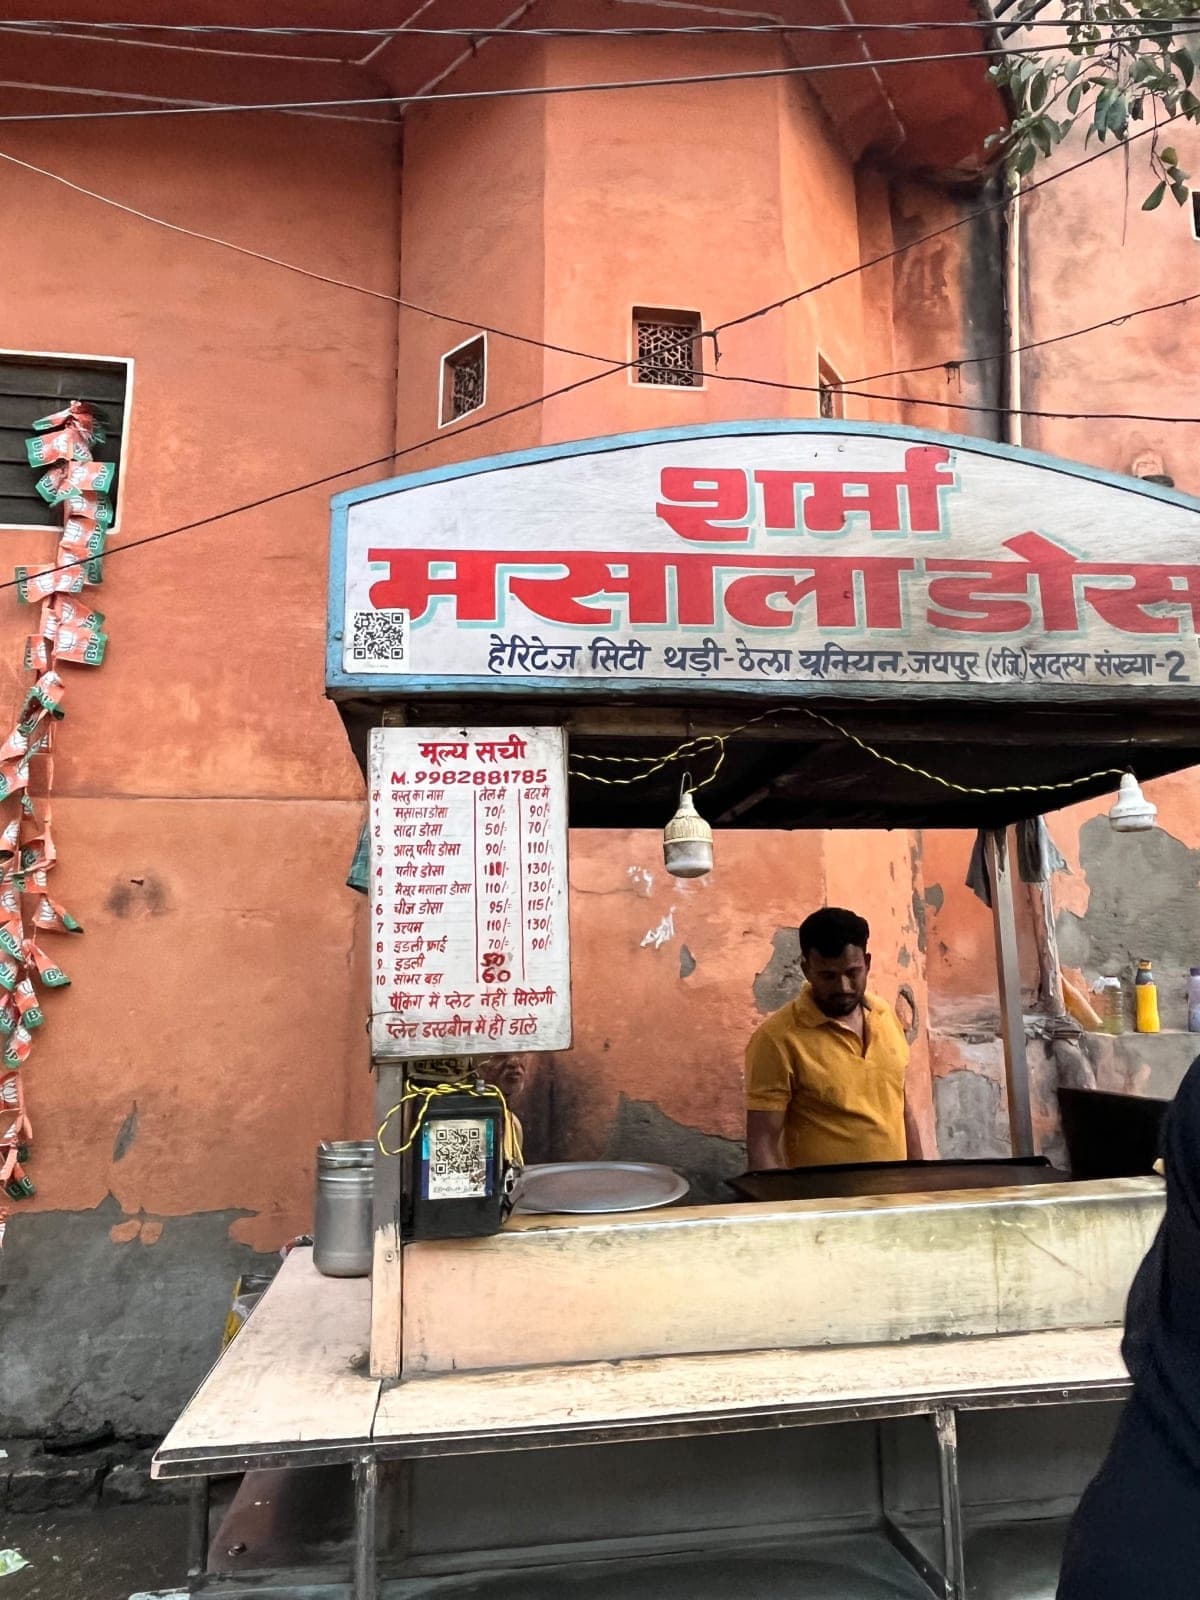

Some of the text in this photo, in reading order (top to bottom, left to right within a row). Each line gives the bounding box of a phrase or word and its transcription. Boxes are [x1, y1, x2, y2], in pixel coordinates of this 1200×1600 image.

[654, 446, 956, 543] शर्मा
[367, 531, 1200, 634] मसाला डोस
[86, 633, 99, 660] BJP
[487, 634, 582, 673] हेरिटेज
[588, 637, 652, 672] सिटी
[907, 650, 980, 681] जयपुर
[1029, 653, 1091, 680] सदस्य
[417, 733, 527, 767] मूल्य सूची
[391, 769, 547, 786] M. 9982881785
[391, 789, 412, 806] वस्तु
[412, 789, 425, 802] का
[393, 824, 416, 838] सादा
[418, 822, 443, 837] डोसा
[393, 844, 415, 859] आलू
[416, 840, 436, 856] पनीर
[438, 840, 461, 857] डोसा
[395, 861, 418, 877] पनीर
[419, 862, 445, 878] डोसा
[377, 885, 384, 896] 5
[449, 880, 472, 896] डोसा
[375, 904, 384, 915] 6
[418, 898, 444, 915] डोसा
[376, 922, 384, 934] 7
[376, 941, 384, 953] 8
[393, 935, 424, 953] इडली
[394, 952, 425, 971] इडली
[376, 974, 386, 986] 10
[482, 966, 511, 983] 60
[444, 990, 475, 1009] प्लेट
[512, 985, 556, 1007] मिलेगी
[488, 1013, 506, 1040] ही
